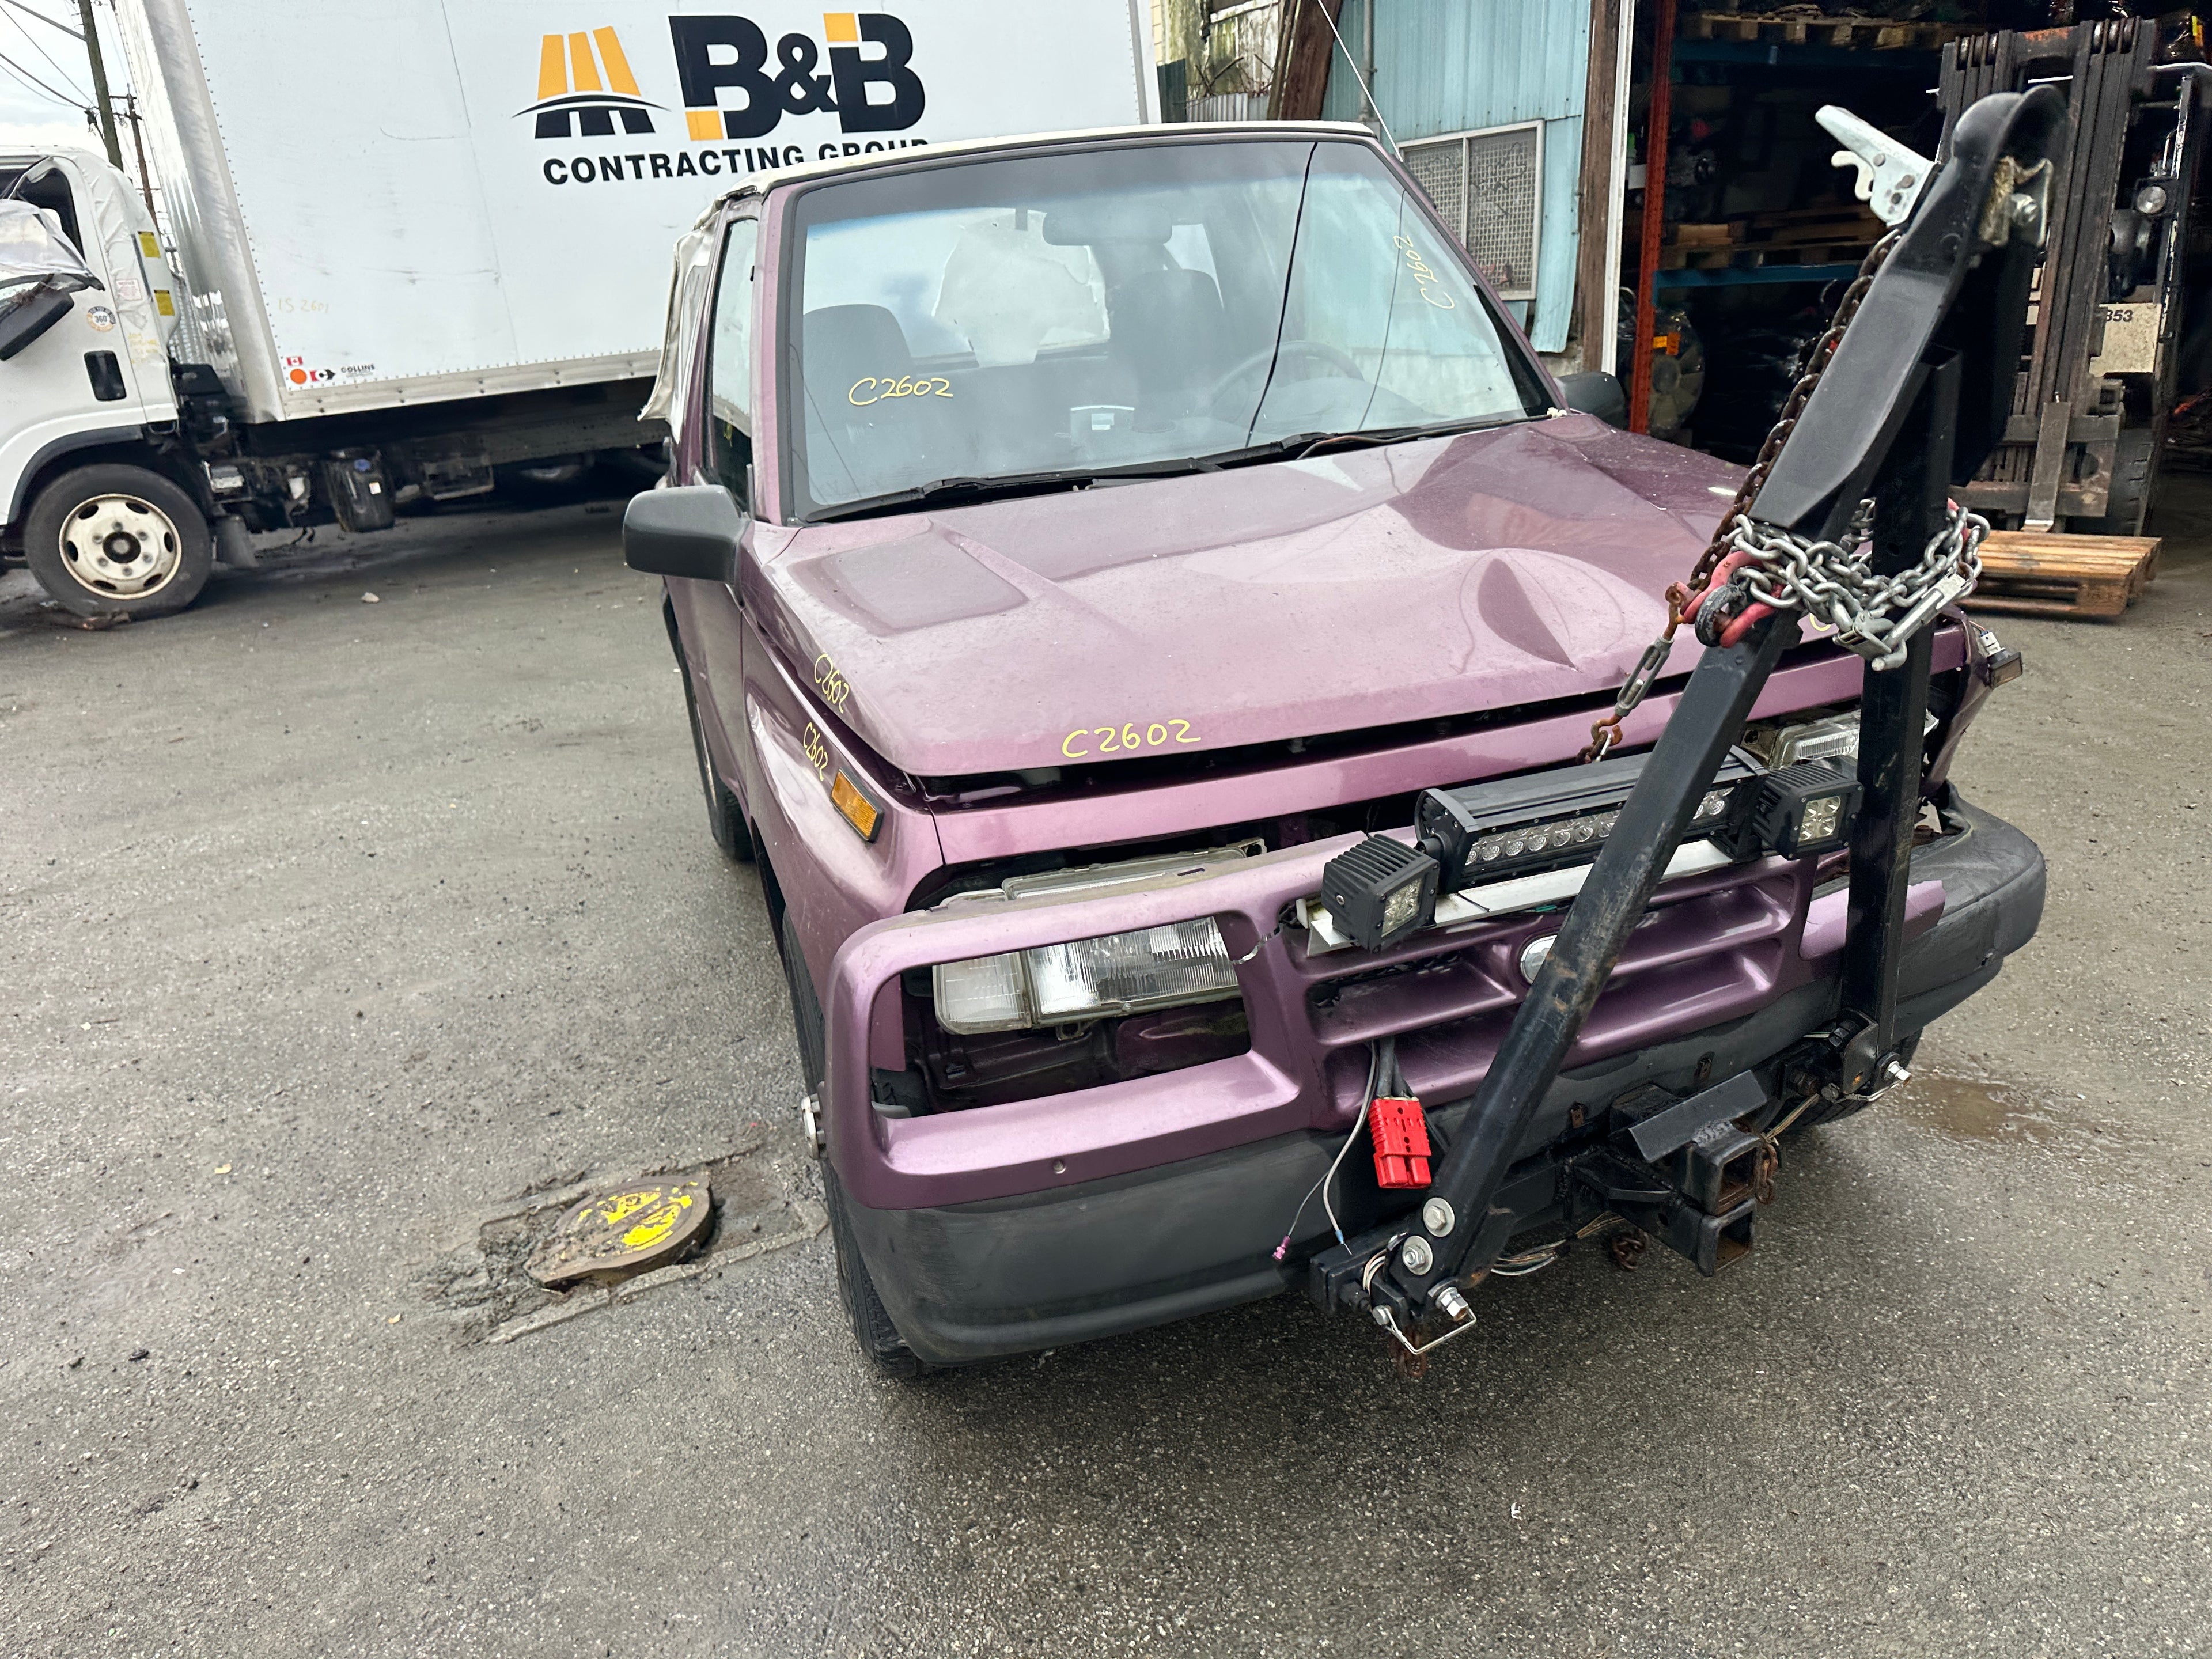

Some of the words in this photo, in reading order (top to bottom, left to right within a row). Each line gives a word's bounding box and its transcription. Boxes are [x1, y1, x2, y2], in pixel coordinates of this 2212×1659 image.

[668, 13, 926, 141] B&B
[543, 145, 804, 185] CONTRACTING
[818, 138, 929, 161] GRO
[1393, 234, 1455, 309] C2602
[340, 363, 376, 373] COLLINS
[848, 375, 954, 406] C2602
[814, 653, 849, 714] C2602
[803, 722, 828, 782] C2602
[1062, 719, 1202, 759] C2602
